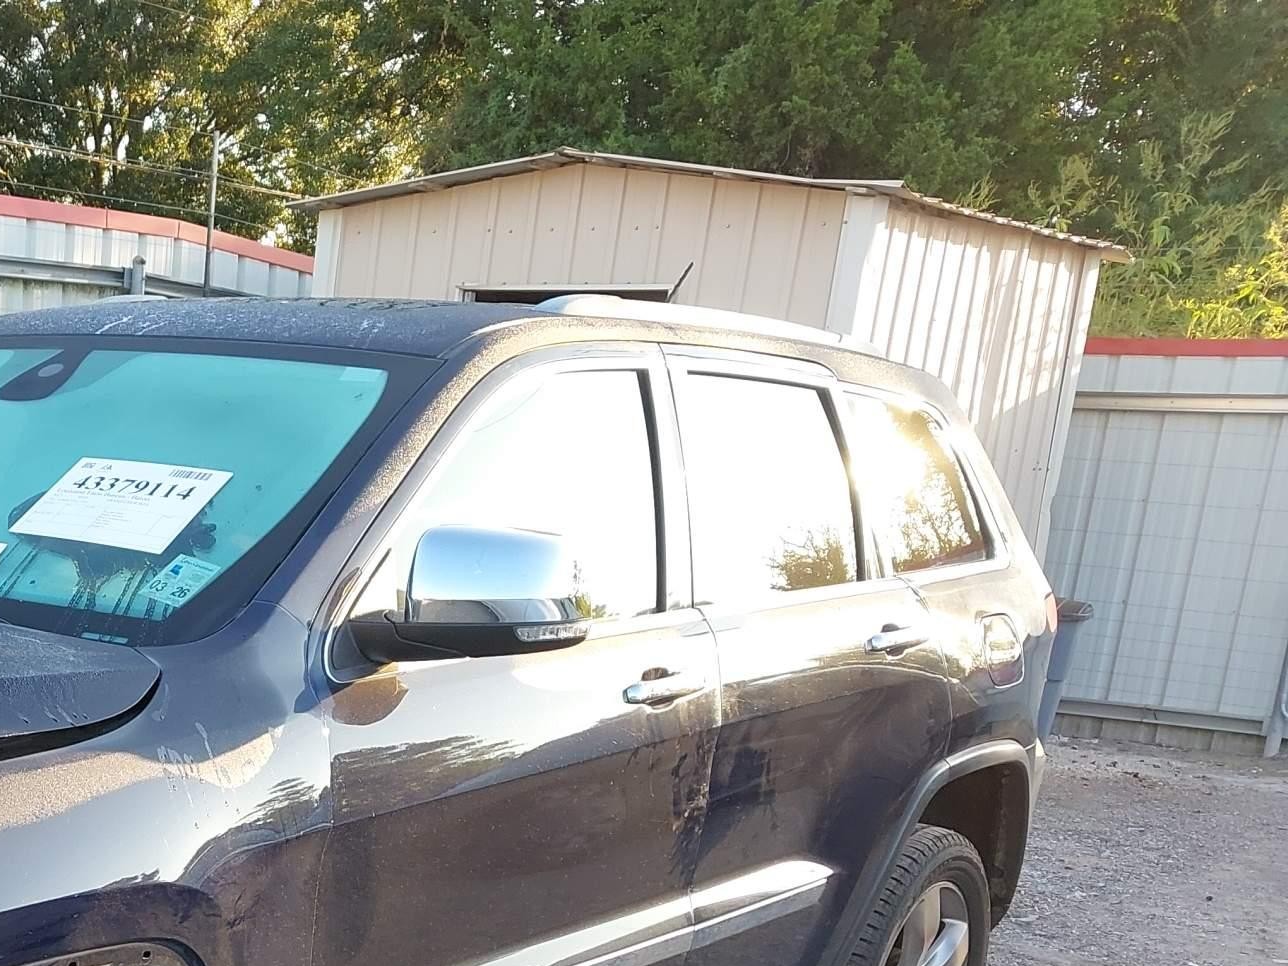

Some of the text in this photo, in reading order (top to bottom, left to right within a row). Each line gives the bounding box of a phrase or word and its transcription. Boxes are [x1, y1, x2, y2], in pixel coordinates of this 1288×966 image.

[73, 475, 197, 501] 43379114
[149, 579, 191, 599] 03 26
